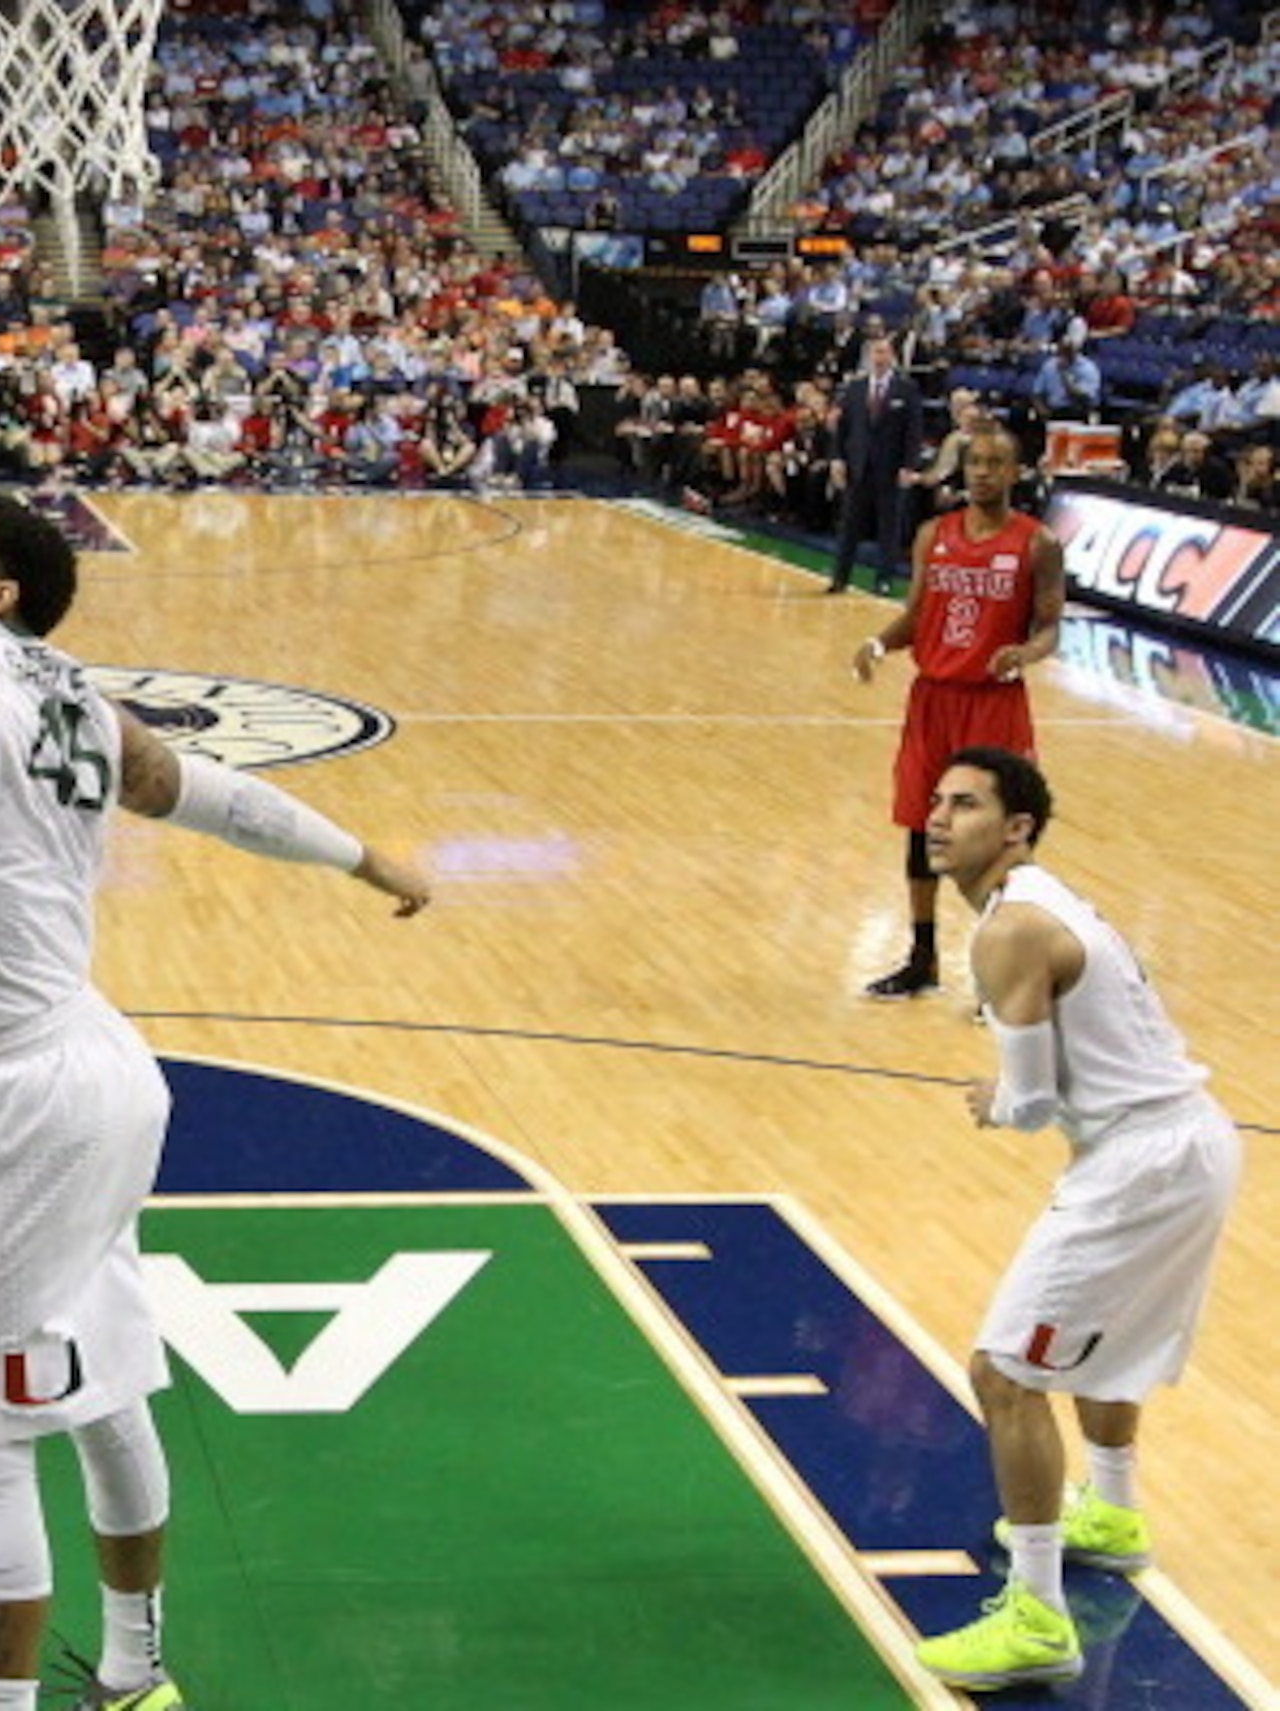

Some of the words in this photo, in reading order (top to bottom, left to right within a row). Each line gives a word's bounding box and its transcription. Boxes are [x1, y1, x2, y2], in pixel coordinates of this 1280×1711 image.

[1063, 502, 1223, 614] ACC
[28, 699, 111, 812] 45
[4, 1337, 83, 1406] U
[1025, 1323, 1103, 1371] U
